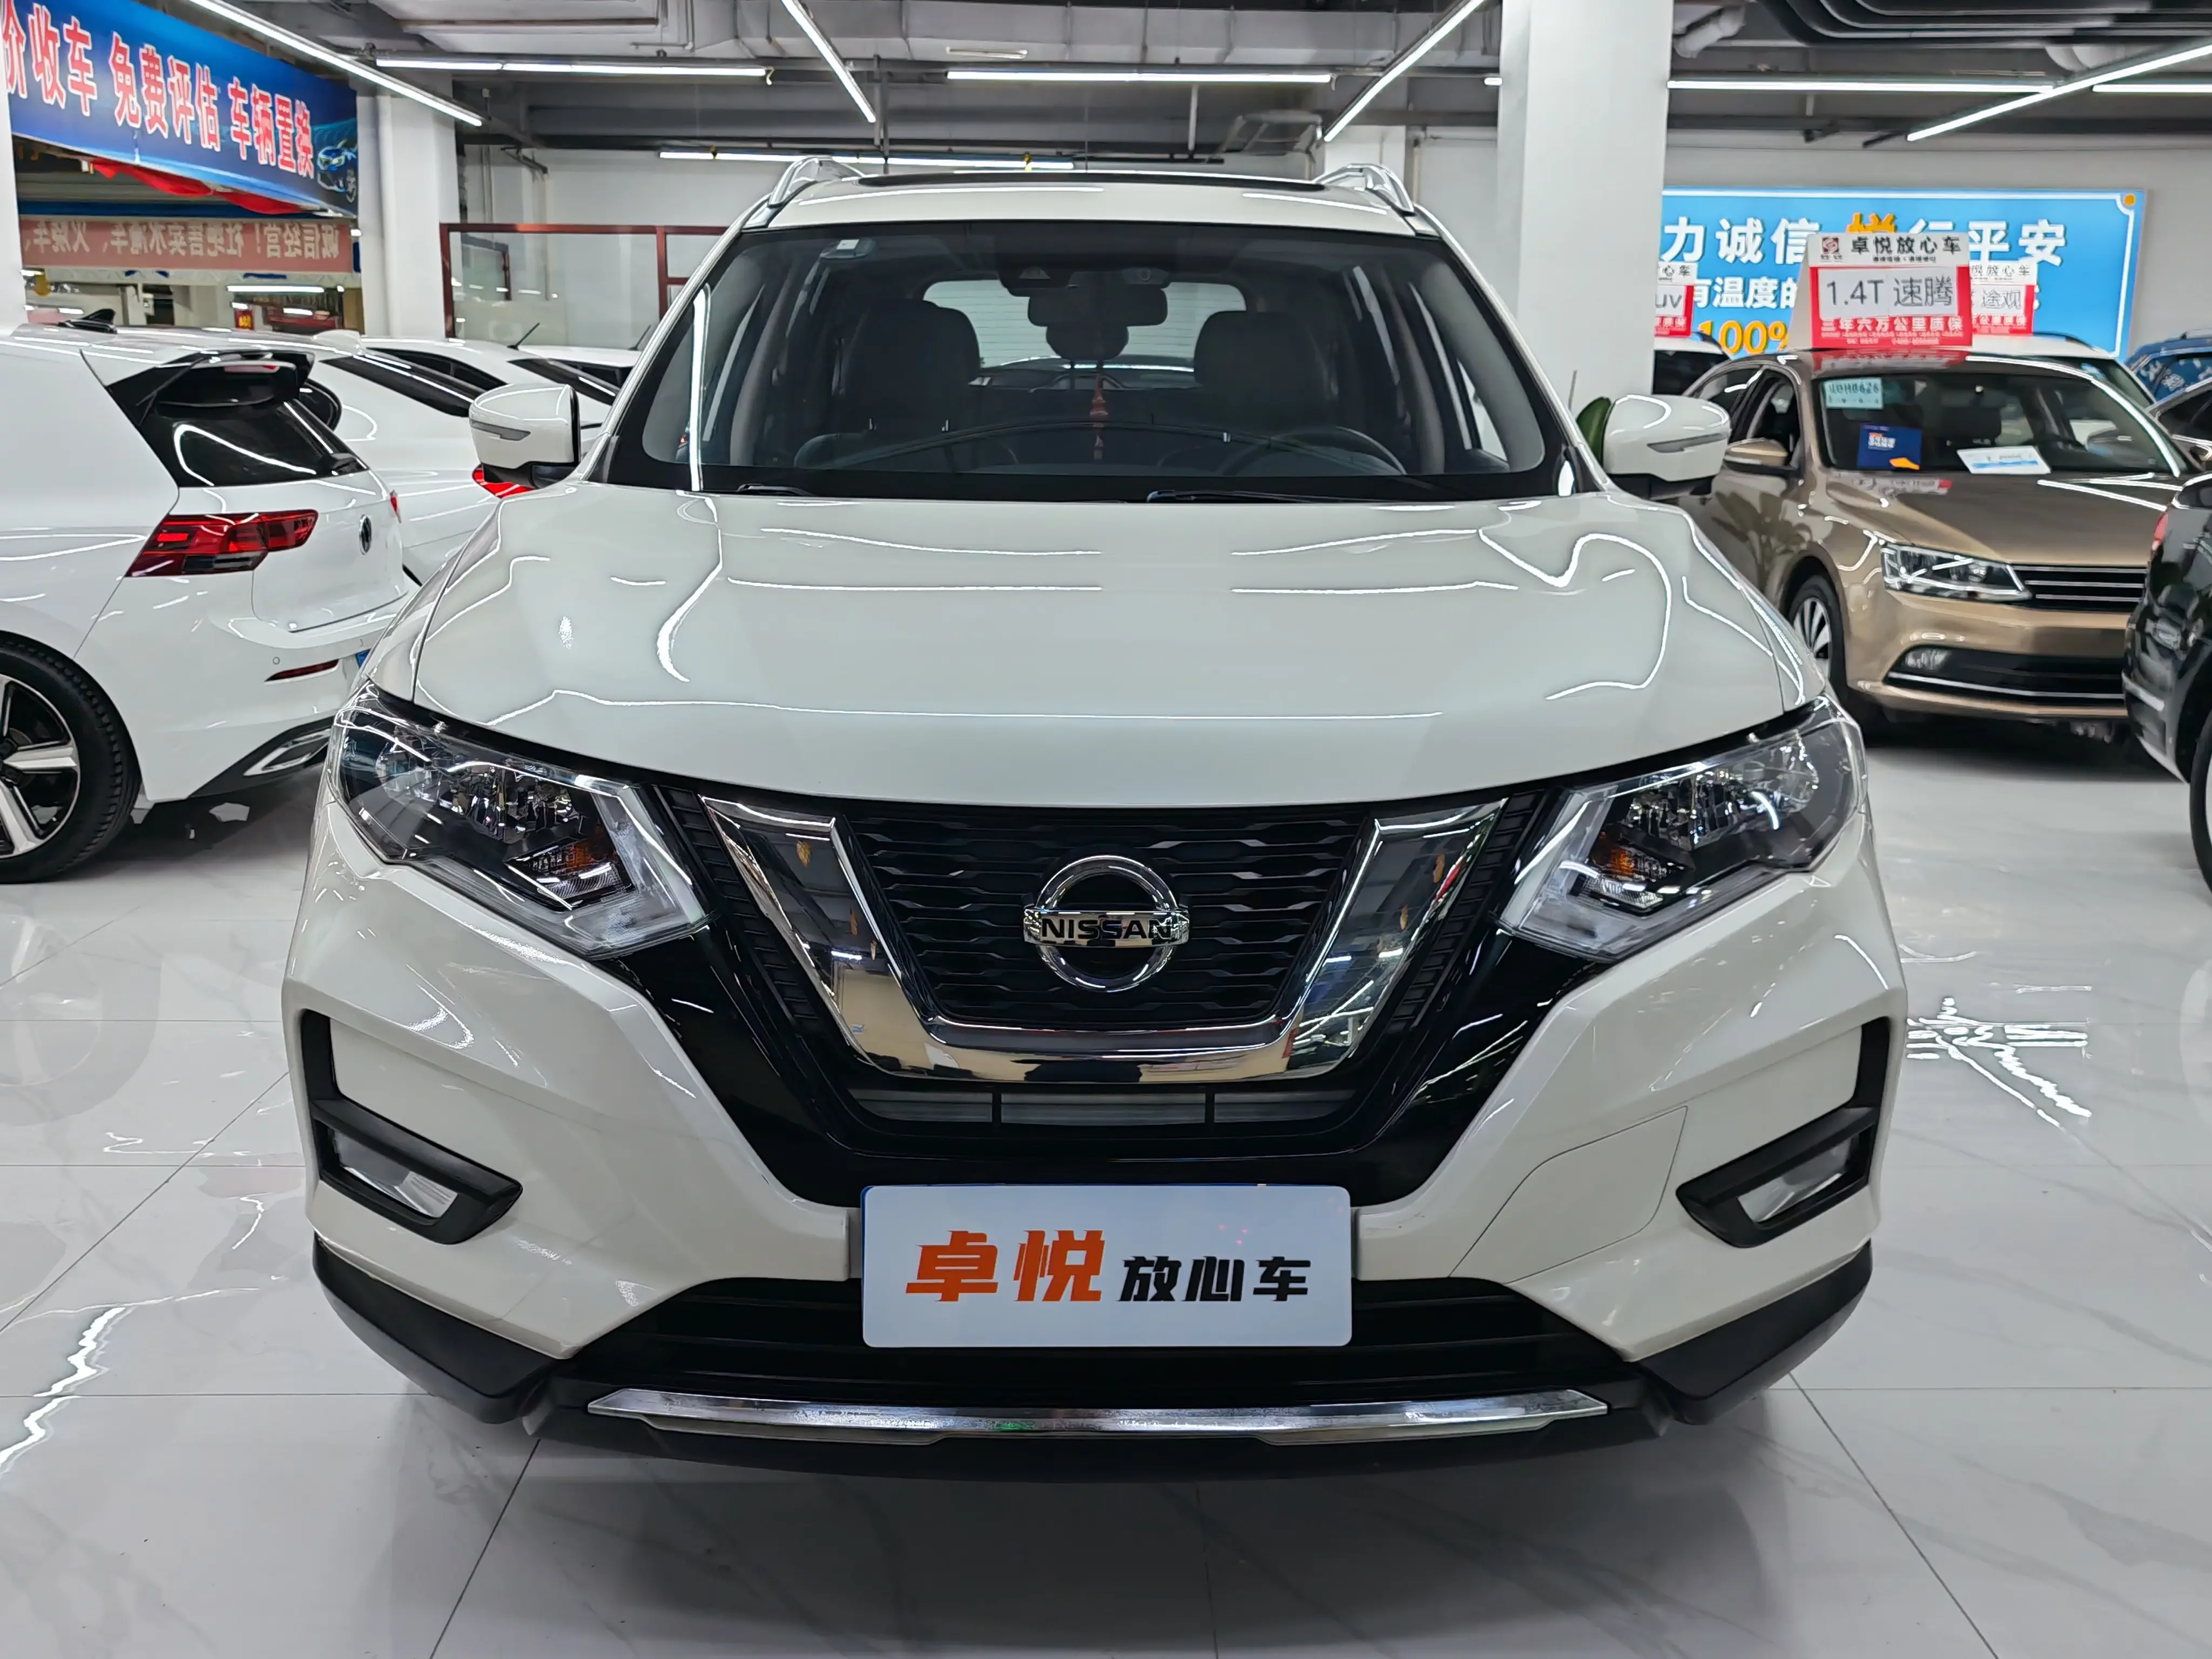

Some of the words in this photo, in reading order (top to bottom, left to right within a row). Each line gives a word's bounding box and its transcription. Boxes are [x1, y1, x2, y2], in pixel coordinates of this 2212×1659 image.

[109, 31, 221, 152] 免费评估
[227, 76, 315, 179] 车辆置换
[1660, 216, 1819, 264] 力诚信
[1851, 235, 1961, 255] 卓悦放心车
[1826, 279, 1885, 306] 1.4T
[1892, 274, 1953, 307] 速腾
[1980, 288, 2022, 310] 途观
[1820, 315, 1963, 332] 三年六万公里质保
[1041, 917, 1172, 940] NISSAN
[905, 1229, 1105, 1303] 卓悦
[1116, 1255, 1312, 1303] 放心车
